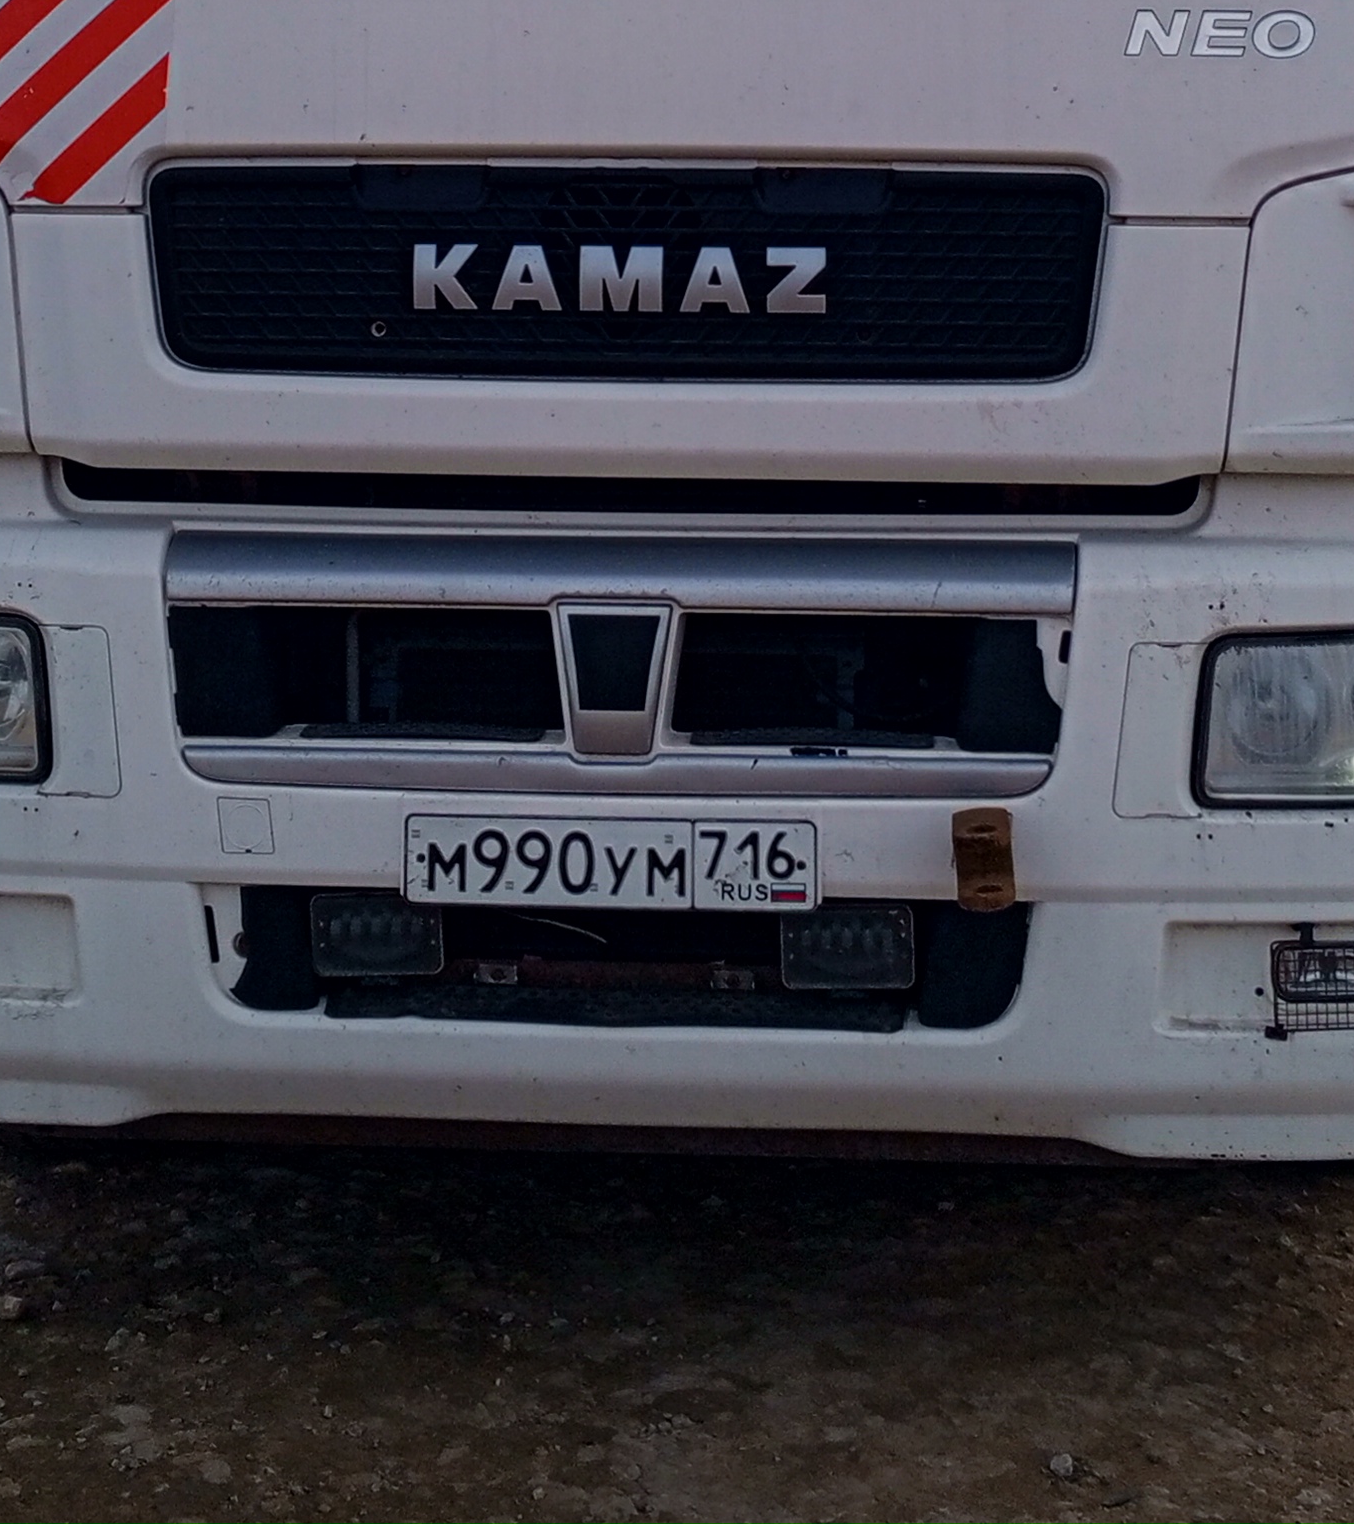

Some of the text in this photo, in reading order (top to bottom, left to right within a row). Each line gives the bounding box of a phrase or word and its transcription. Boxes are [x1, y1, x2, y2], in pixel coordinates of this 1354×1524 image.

[1123, 8, 1316, 59] NEO
[412, 243, 827, 314] KAMAZ
[698, 829, 797, 881] 716
[721, 882, 770, 902] RUS
